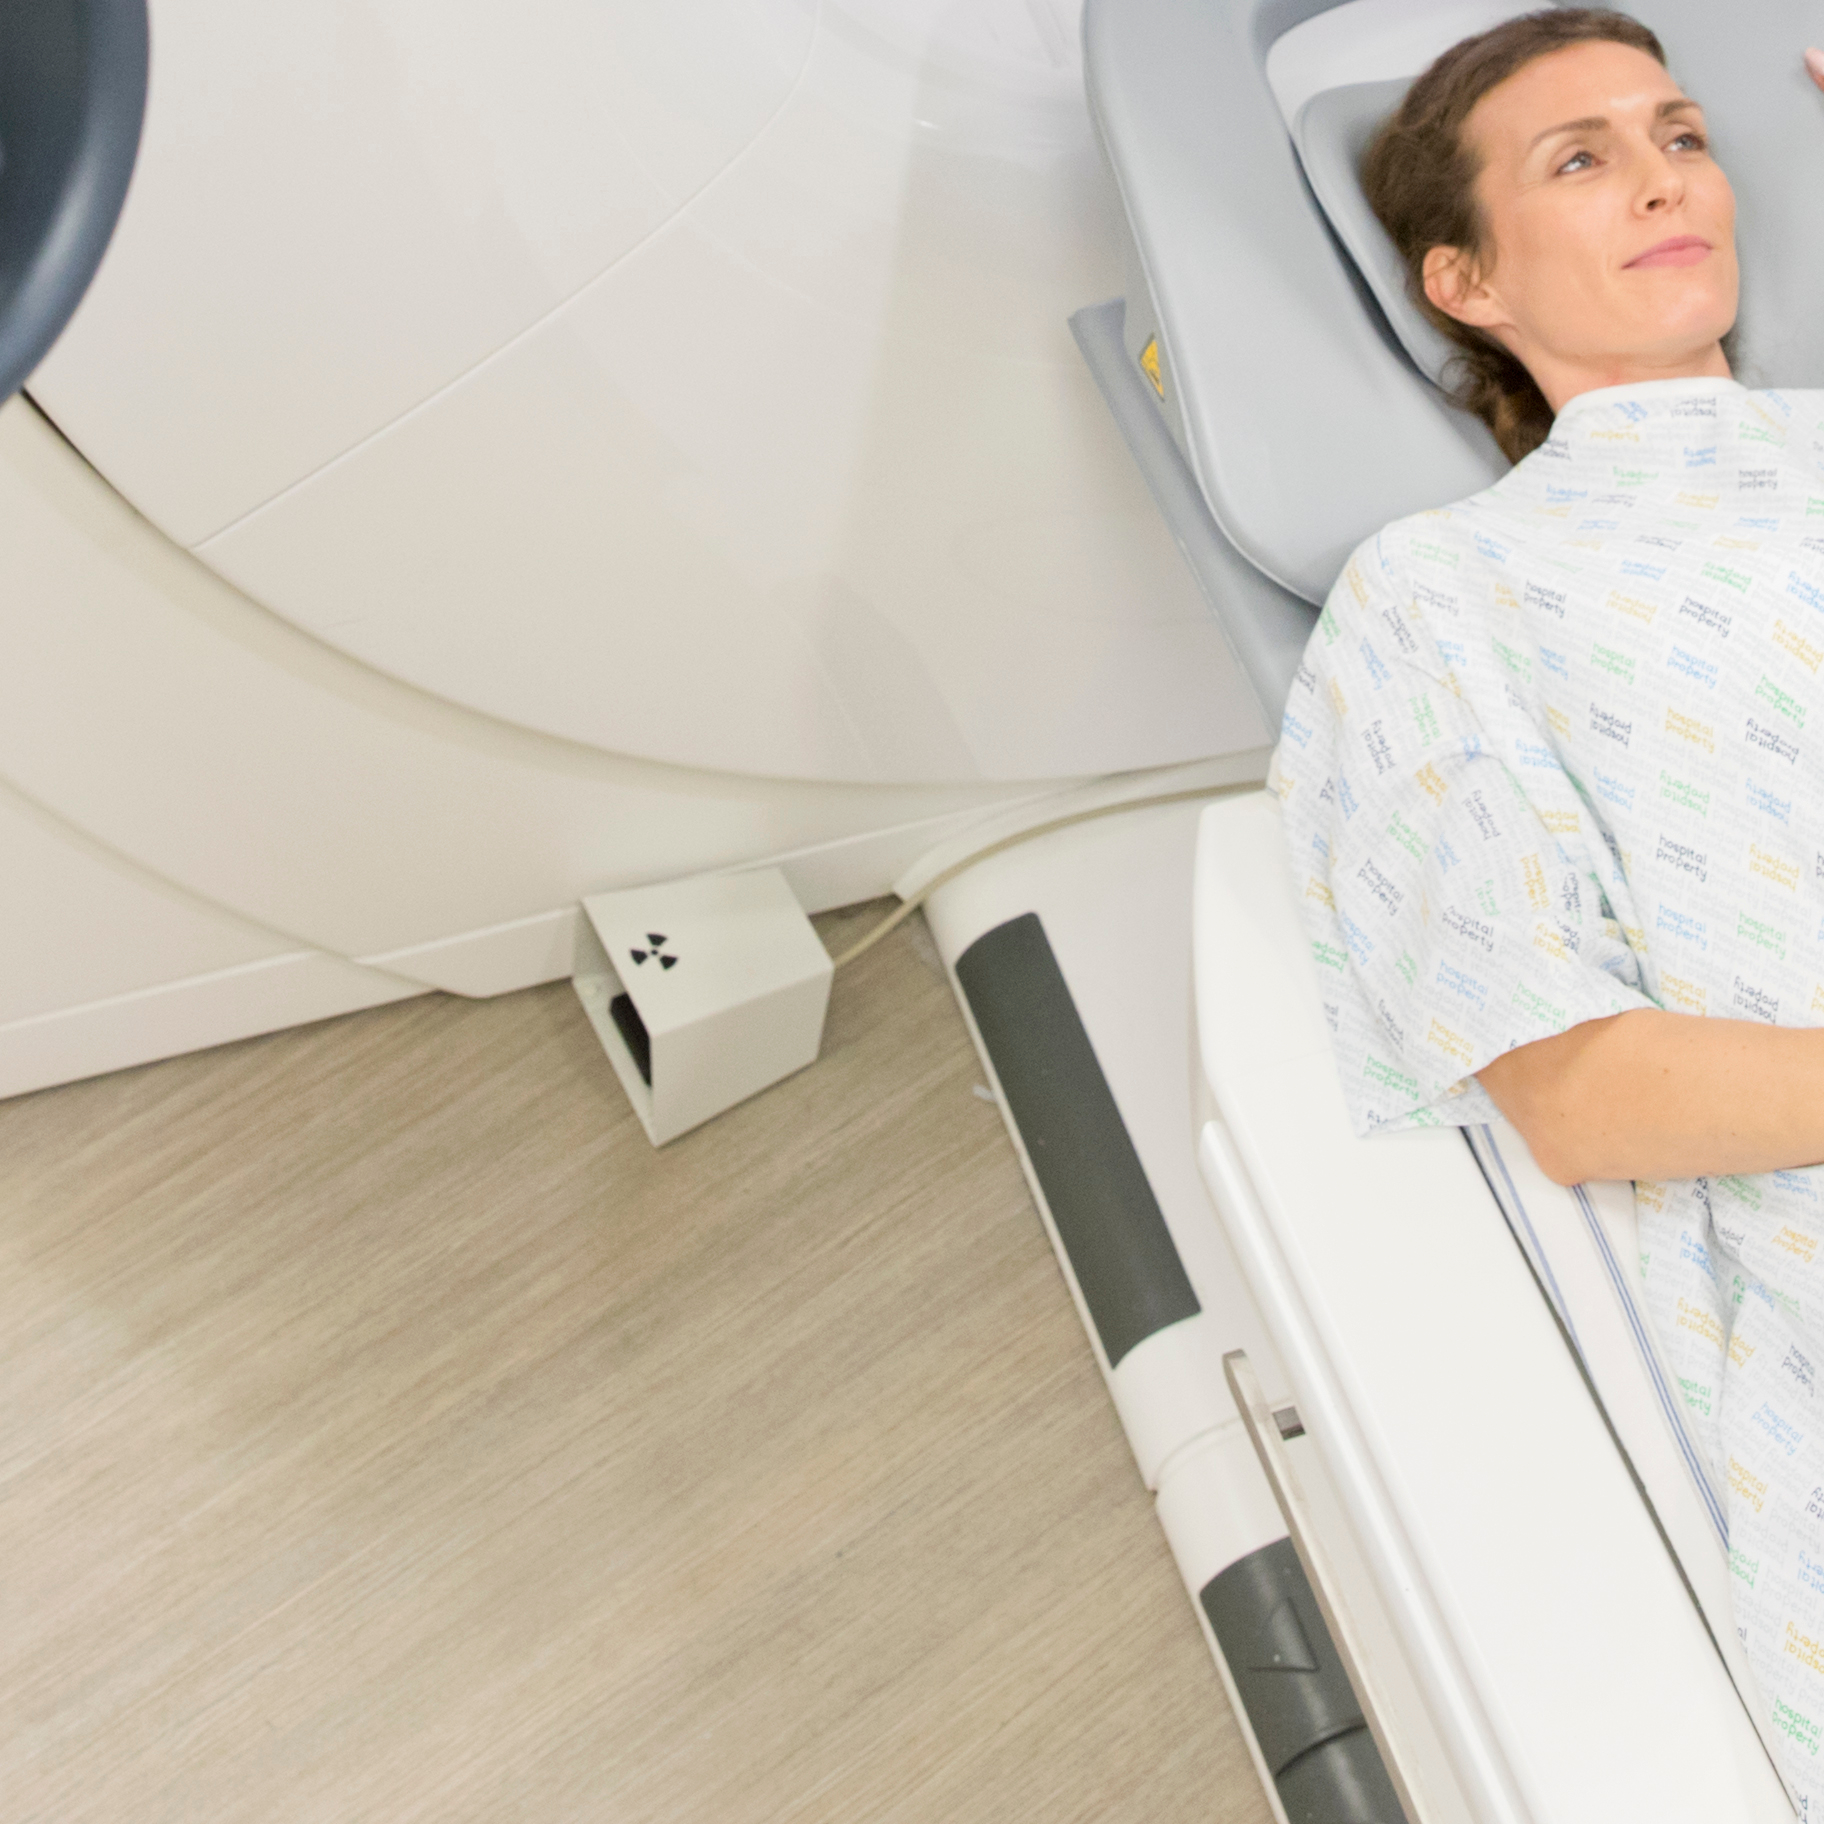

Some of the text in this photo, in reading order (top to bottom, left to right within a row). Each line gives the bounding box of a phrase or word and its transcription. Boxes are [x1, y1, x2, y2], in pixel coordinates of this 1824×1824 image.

[1679, 605, 1729, 638] property
[1685, 597, 1731, 625] hospital
[1656, 848, 1707, 882] property
[1660, 835, 1706, 864] hospital
[1358, 868, 1397, 916] property
[1365, 858, 1403, 901] hospital
[1427, 1030, 1472, 1067] property
[1431, 1018, 1473, 1052] hospital
